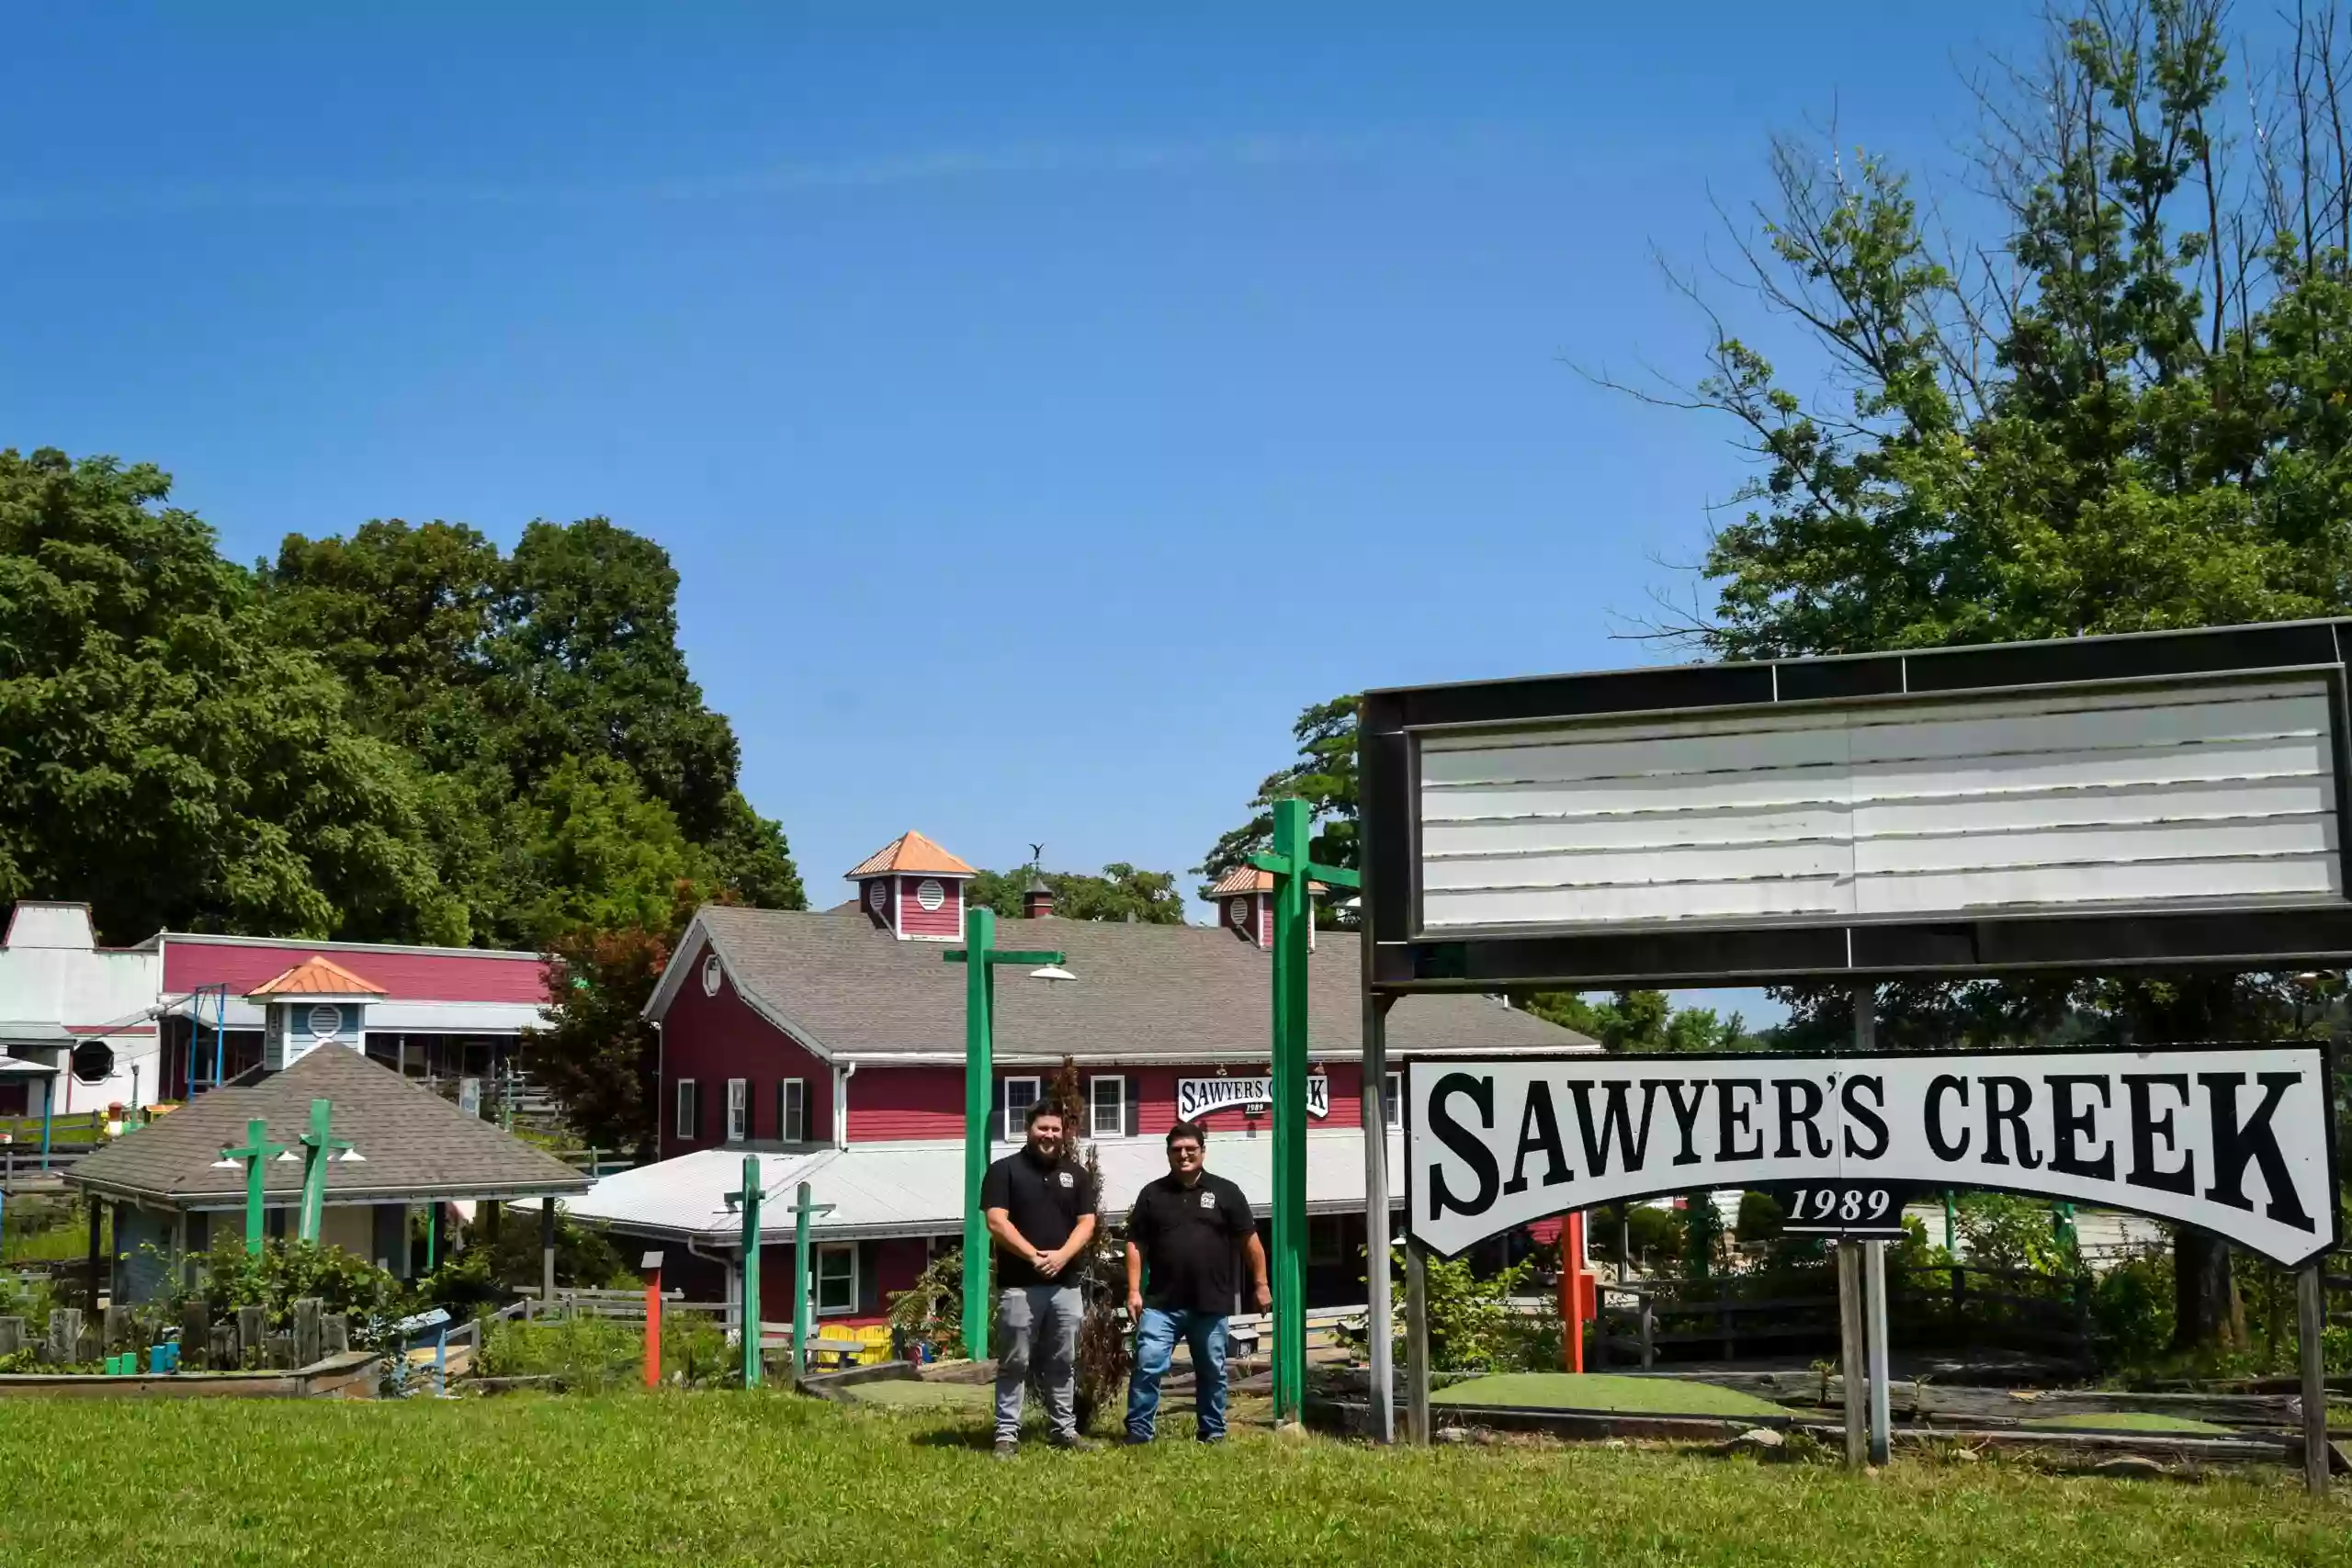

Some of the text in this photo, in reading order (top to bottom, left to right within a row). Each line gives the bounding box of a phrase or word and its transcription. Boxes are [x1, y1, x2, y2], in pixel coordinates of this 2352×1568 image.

[1182, 1080, 1263, 1114] SAWYER'S
[1246, 1103, 1263, 1111] 1989
[1428, 1072, 2316, 1234] SAWYER'S CREEK
[1789, 1190, 1891, 1221] 1989
